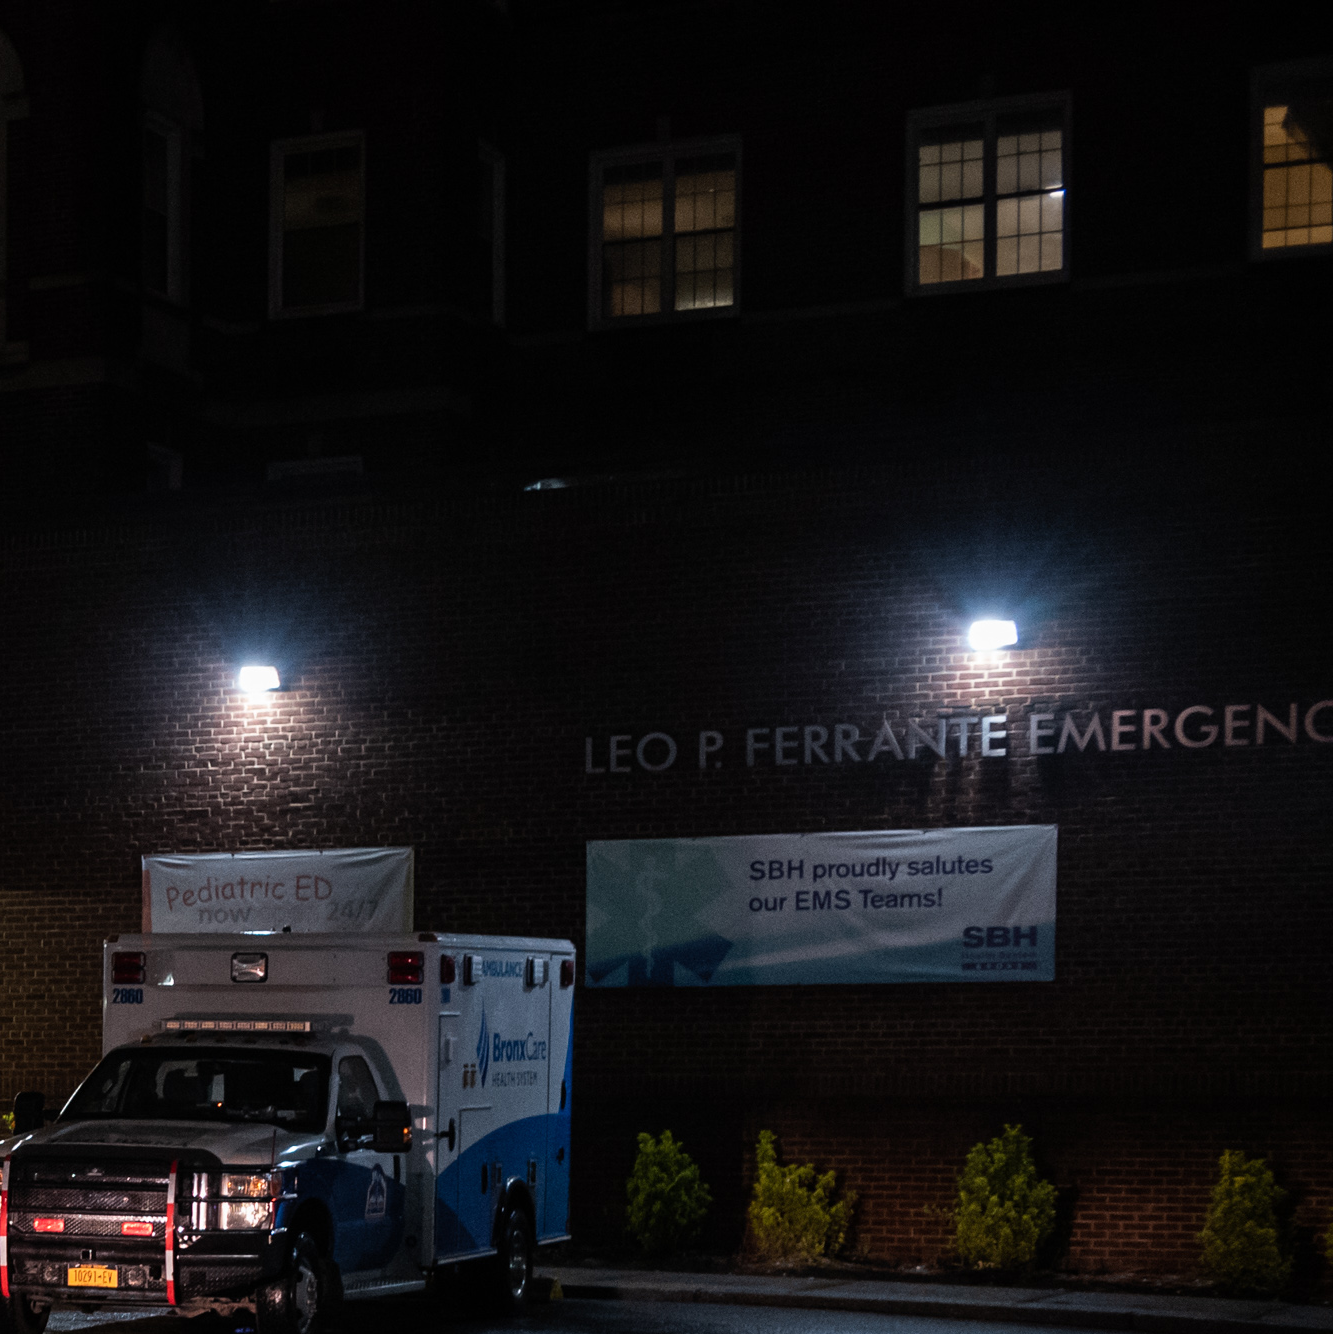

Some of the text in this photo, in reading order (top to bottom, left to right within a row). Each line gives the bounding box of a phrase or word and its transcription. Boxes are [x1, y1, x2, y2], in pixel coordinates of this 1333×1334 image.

[585, 731, 678, 774] LEO
[698, 730, 724, 769] P.
[746, 714, 1007, 767] FERRANTE
[749, 856, 994, 882] SBH proudly salutes
[295, 874, 334, 902] ED
[749, 888, 943, 912] our EMS Teams!
[199, 907, 252, 924] now
[963, 926, 1038, 949] SBH
[112, 988, 144, 1004] 2860
[389, 988, 422, 1005] 2860
[493, 1031, 547, 1063] BronxCare
[492, 1070, 538, 1088] HEALTH SYSTEM
